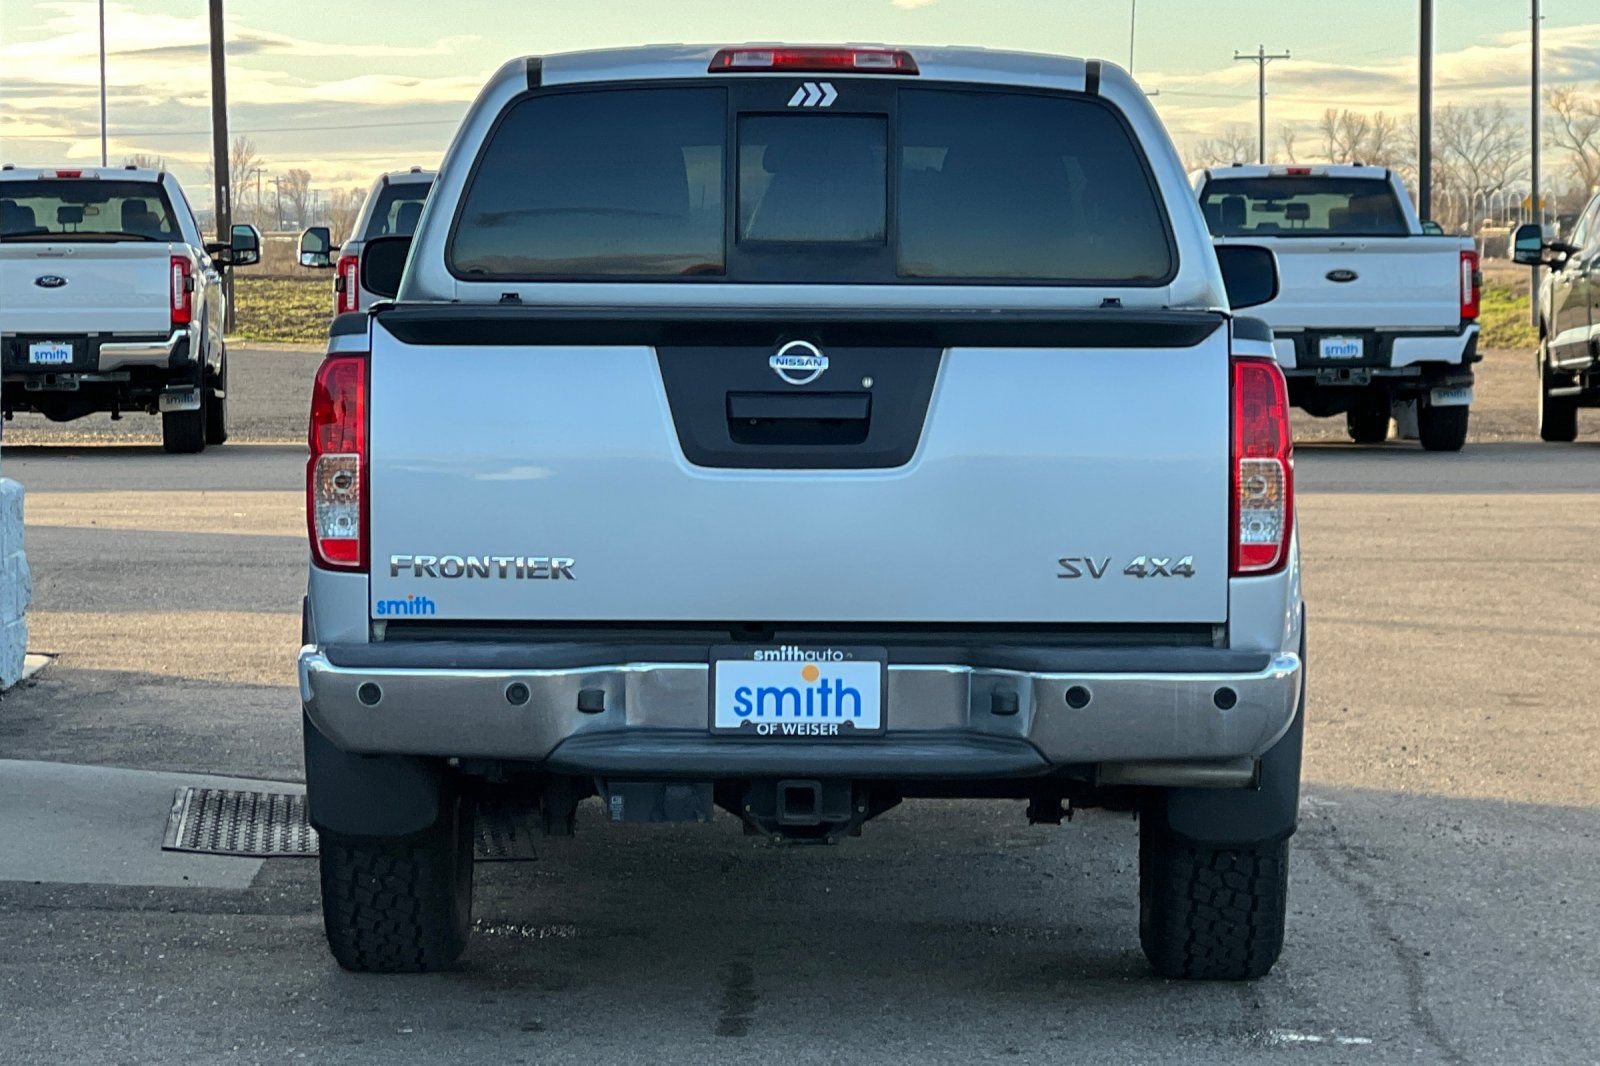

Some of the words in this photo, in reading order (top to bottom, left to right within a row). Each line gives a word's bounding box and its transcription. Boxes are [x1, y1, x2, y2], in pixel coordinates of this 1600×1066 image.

[34, 346, 68, 360] smith
[1325, 339, 1359, 355] smith
[775, 358, 822, 366] NISSAN
[390, 555, 576, 580] FRONTIER
[1057, 556, 1110, 579] SV
[376, 594, 435, 615] smith
[753, 645, 843, 661] smithauto
[733, 664, 862, 717] smith
[756, 723, 777, 736] OF
[782, 723, 839, 736] WEISER
